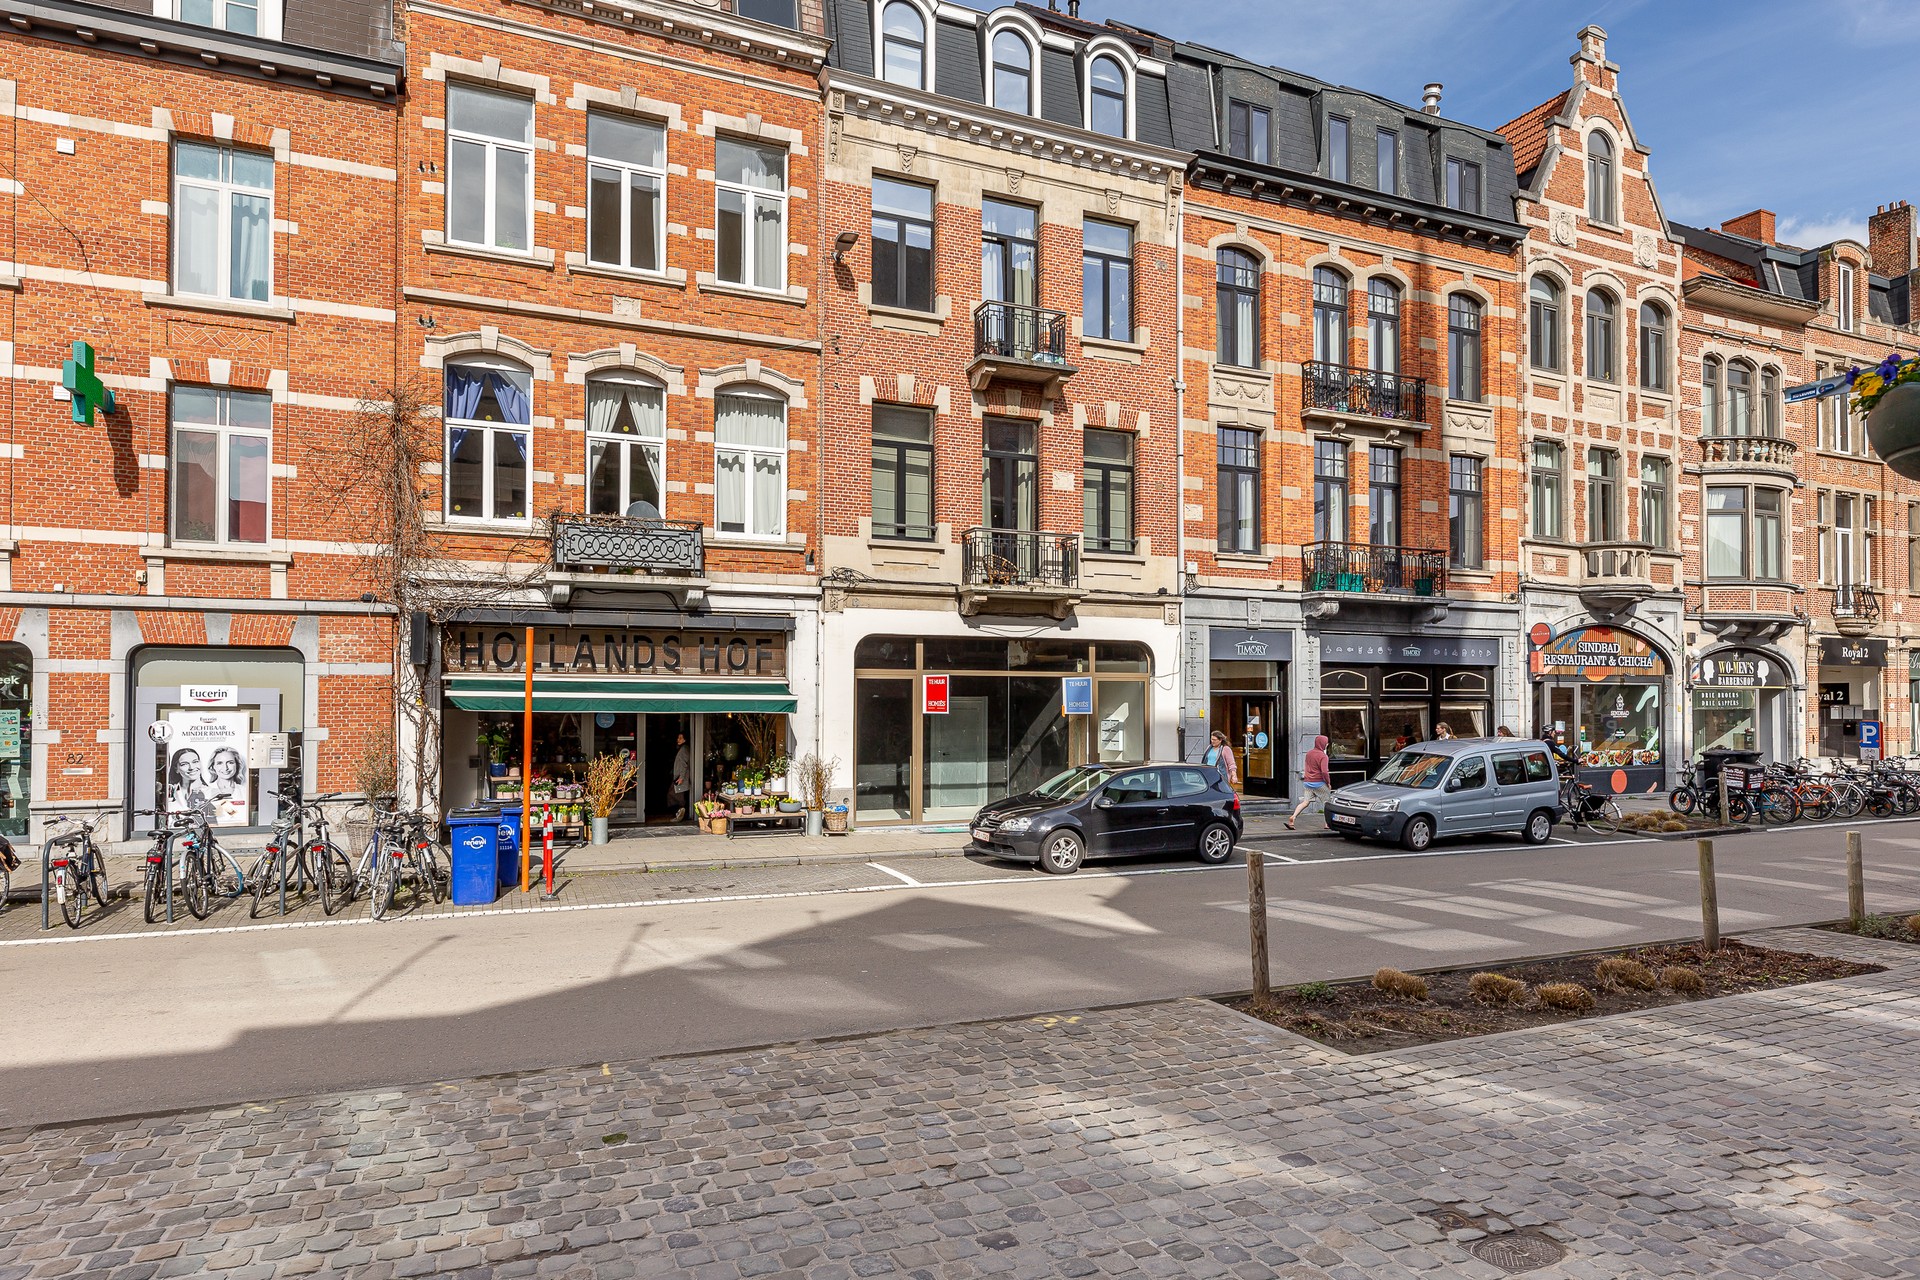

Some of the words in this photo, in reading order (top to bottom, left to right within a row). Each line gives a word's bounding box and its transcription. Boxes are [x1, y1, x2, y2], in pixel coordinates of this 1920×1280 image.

[459, 631, 681, 671] HOLANDS
[699, 636, 773, 673] HOF
[1236, 645, 1268, 655] TIMORY
[1578, 642, 1620, 653] SINDBAD
[1842, 646, 1864, 660] Royal
[1863, 648, 1869, 658] 2
[1544, 654, 1607, 666] RESTAURANT
[1608, 655, 1617, 666] &
[1617, 655, 1653, 667] CHICHA
[1718, 660, 1754, 674] WO-MEN'S
[1718, 677, 1754, 686] BARBERSHOP
[189, 688, 228, 698] Eucerin
[1836, 691, 1844, 701] 2
[1862, 725, 1877, 744] P
[66, 753, 84, 765] 82
[463, 838, 487, 846] renewi
